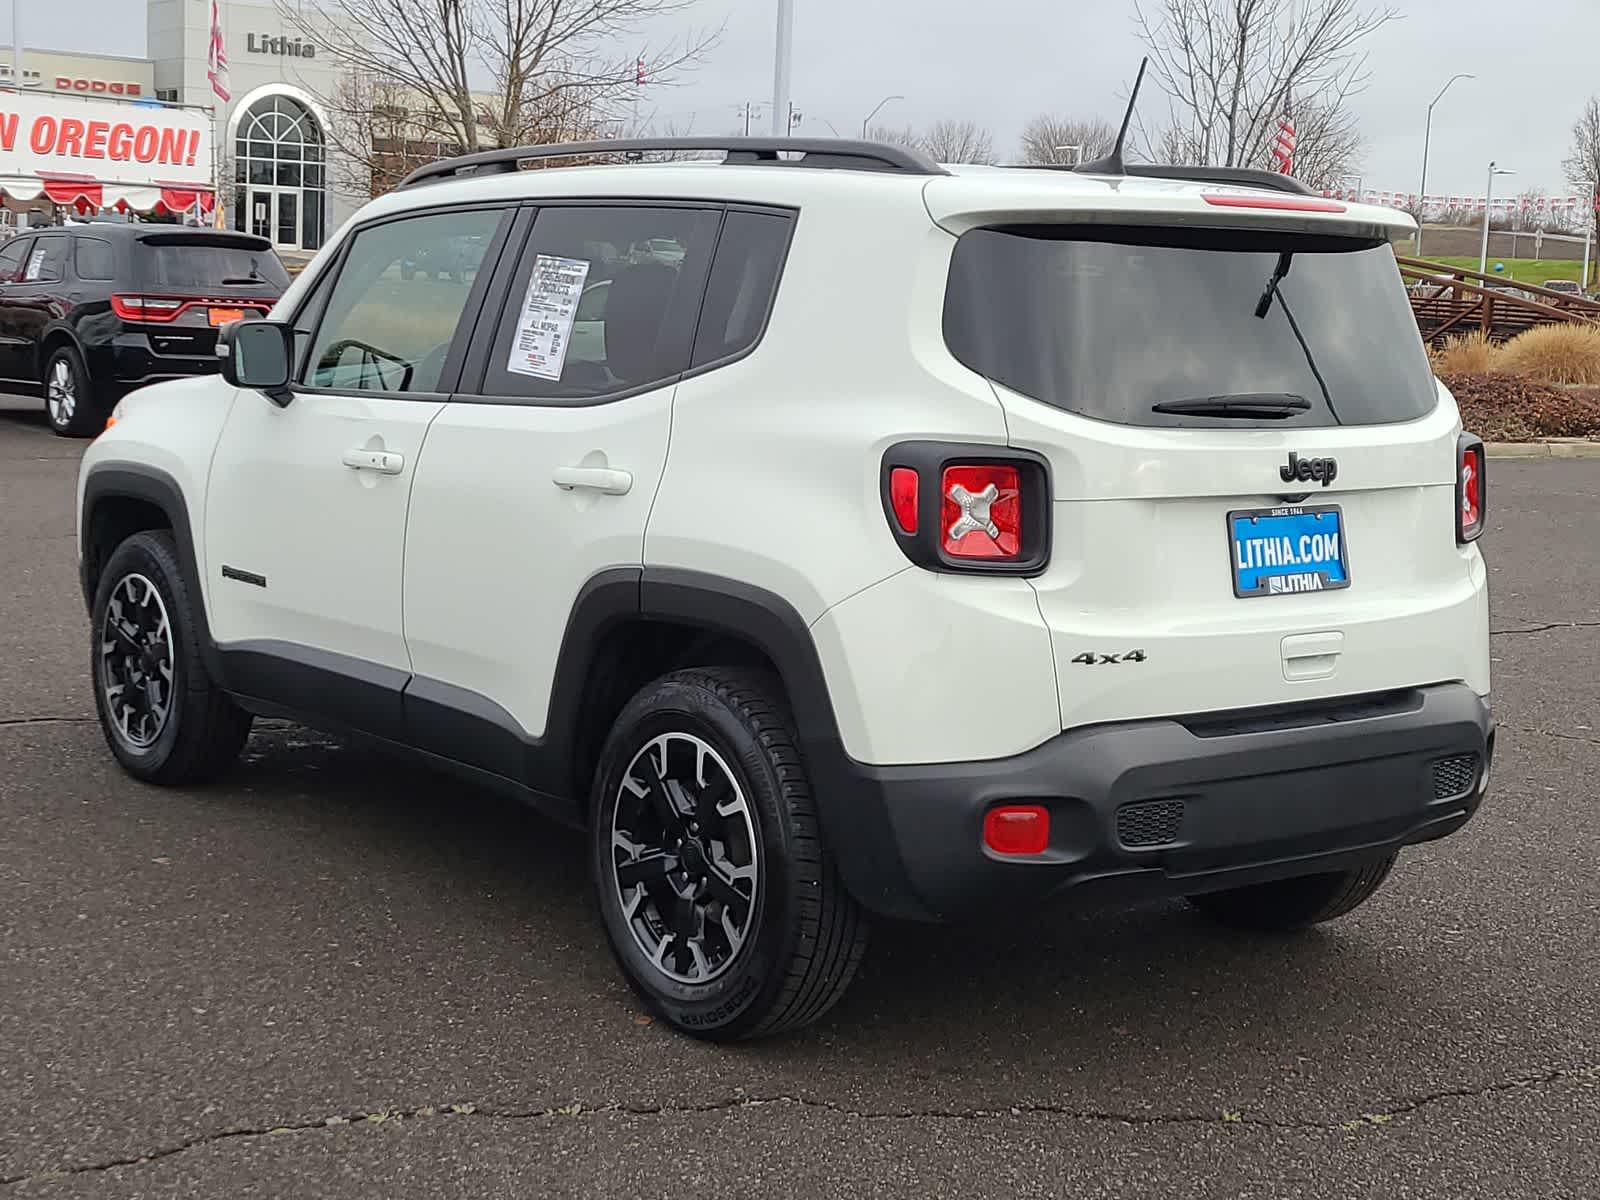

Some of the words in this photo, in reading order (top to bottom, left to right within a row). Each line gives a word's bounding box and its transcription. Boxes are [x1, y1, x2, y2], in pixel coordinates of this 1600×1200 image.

[248, 33, 315, 57] Lithia
[56, 77, 141, 95] DODGE
[30, 115, 200, 166] OREGON!
[1280, 452, 1337, 487] Jeep
[1236, 533, 1339, 569] LITHIA.COM
[1282, 572, 1322, 592] LITHIA
[1071, 648, 1147, 665] 4x4
